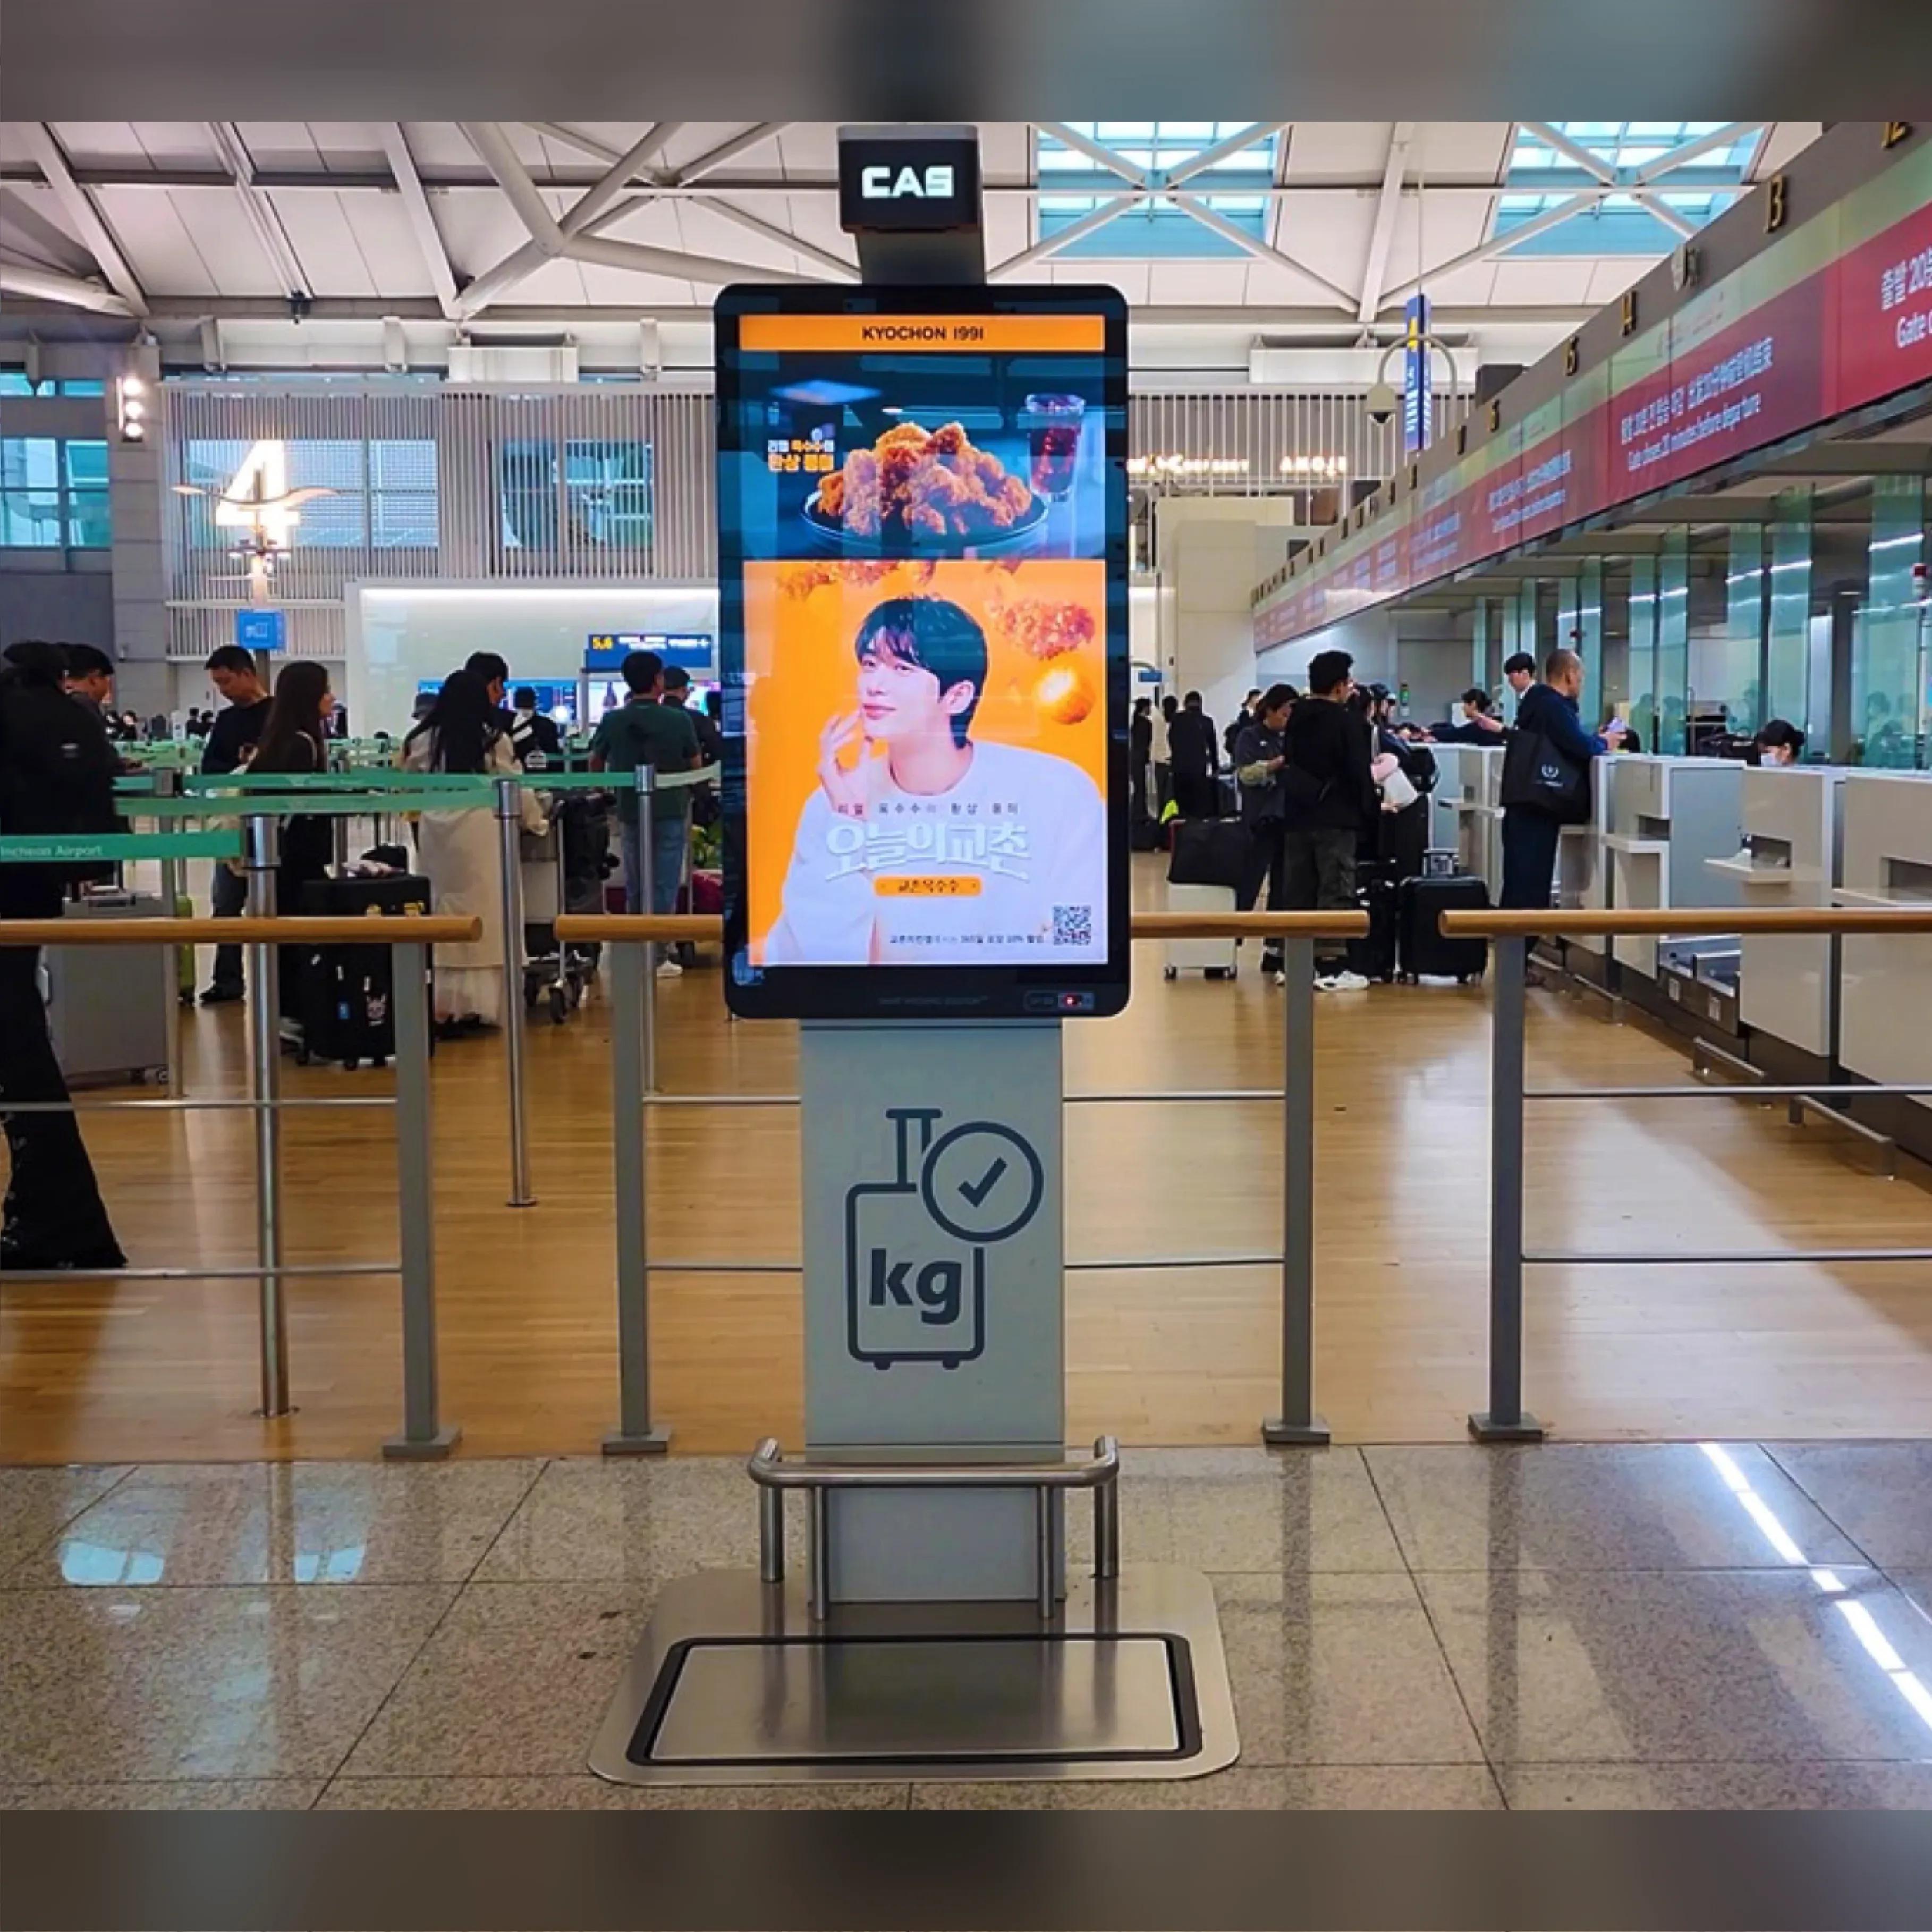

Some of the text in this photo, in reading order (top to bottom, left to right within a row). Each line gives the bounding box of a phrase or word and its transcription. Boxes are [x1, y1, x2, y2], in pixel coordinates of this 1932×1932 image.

[861, 165, 954, 199] CAS
[862, 326, 984, 341] KYOCHON 1991
[215, 439, 301, 549] 4
[0, 845, 103, 858] Incheon Airport
[869, 1248, 962, 1325] kg
